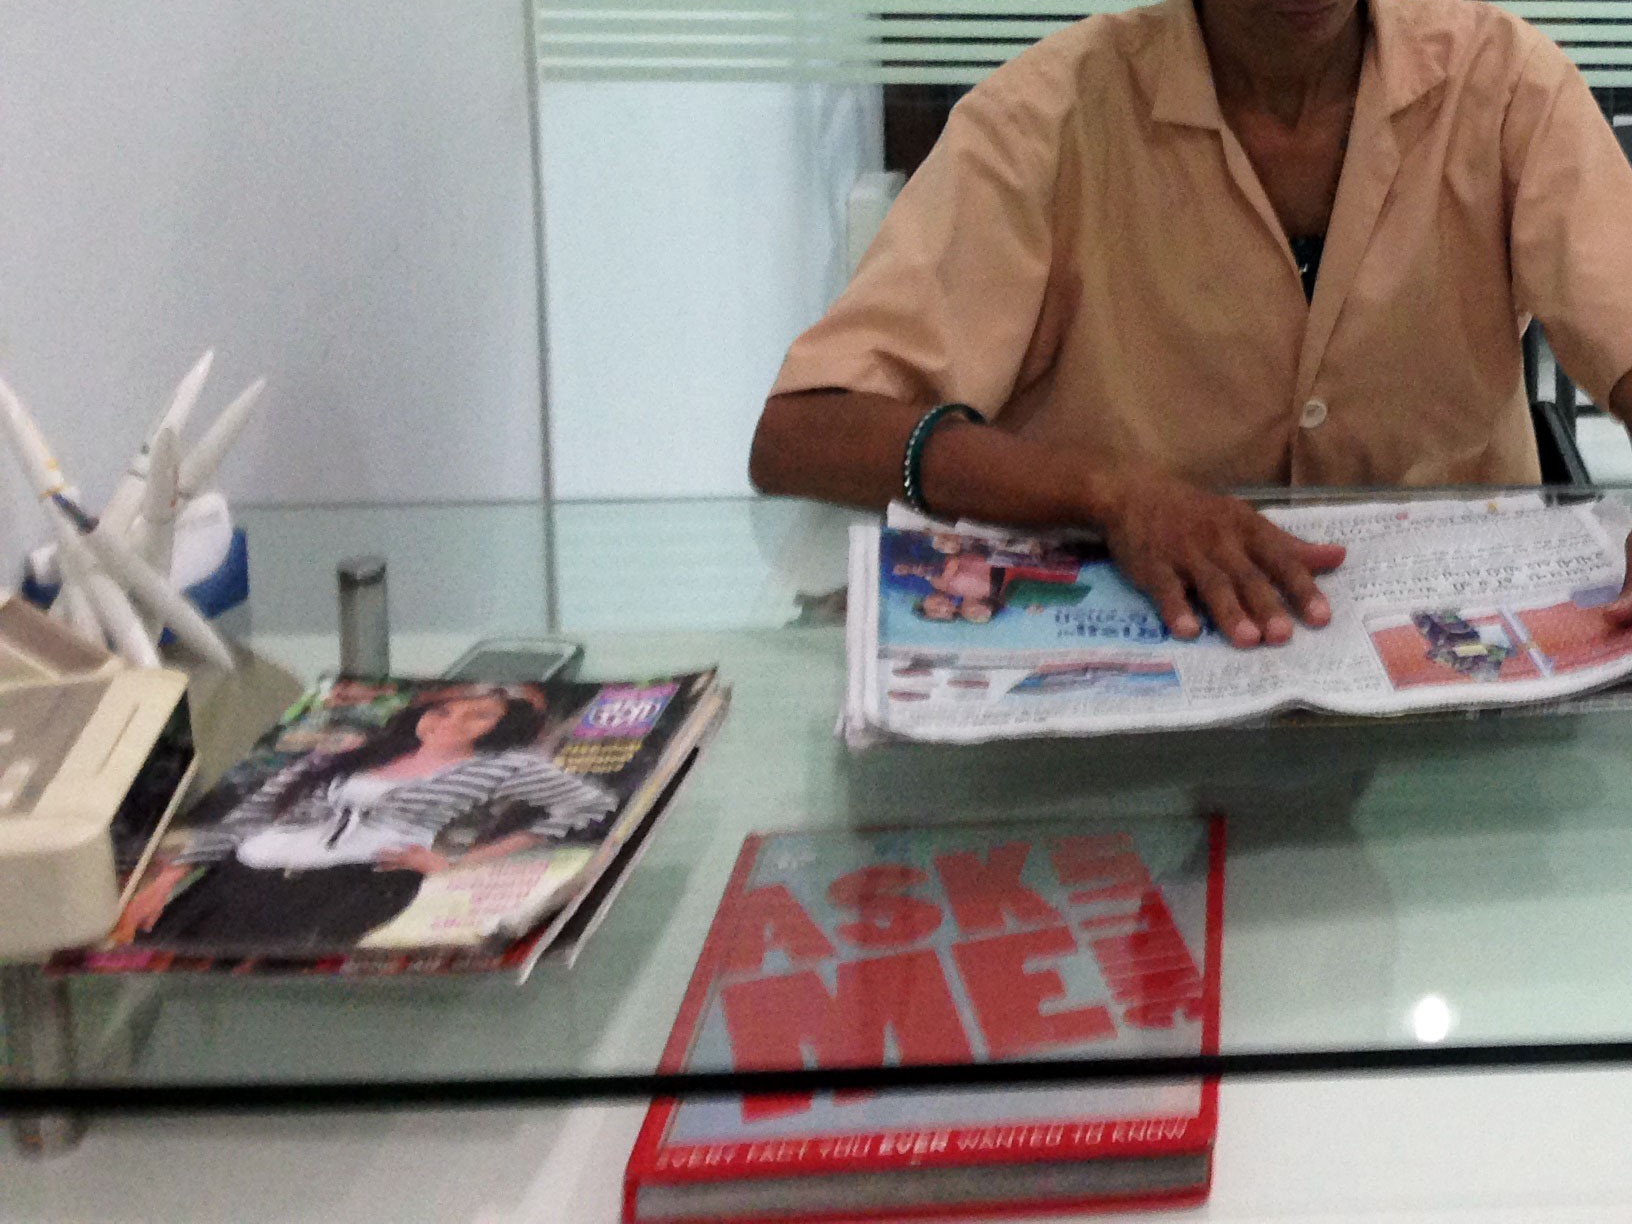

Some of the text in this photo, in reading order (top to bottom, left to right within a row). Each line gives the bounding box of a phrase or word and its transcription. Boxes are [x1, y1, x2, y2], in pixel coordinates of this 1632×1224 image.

[704, 839, 1070, 973] ASK
[877, 1129, 951, 1156] EVER
[956, 1123, 1065, 1152] WANTED
[1072, 1121, 1106, 1145] TO
[1110, 1118, 1190, 1144] KNOW
